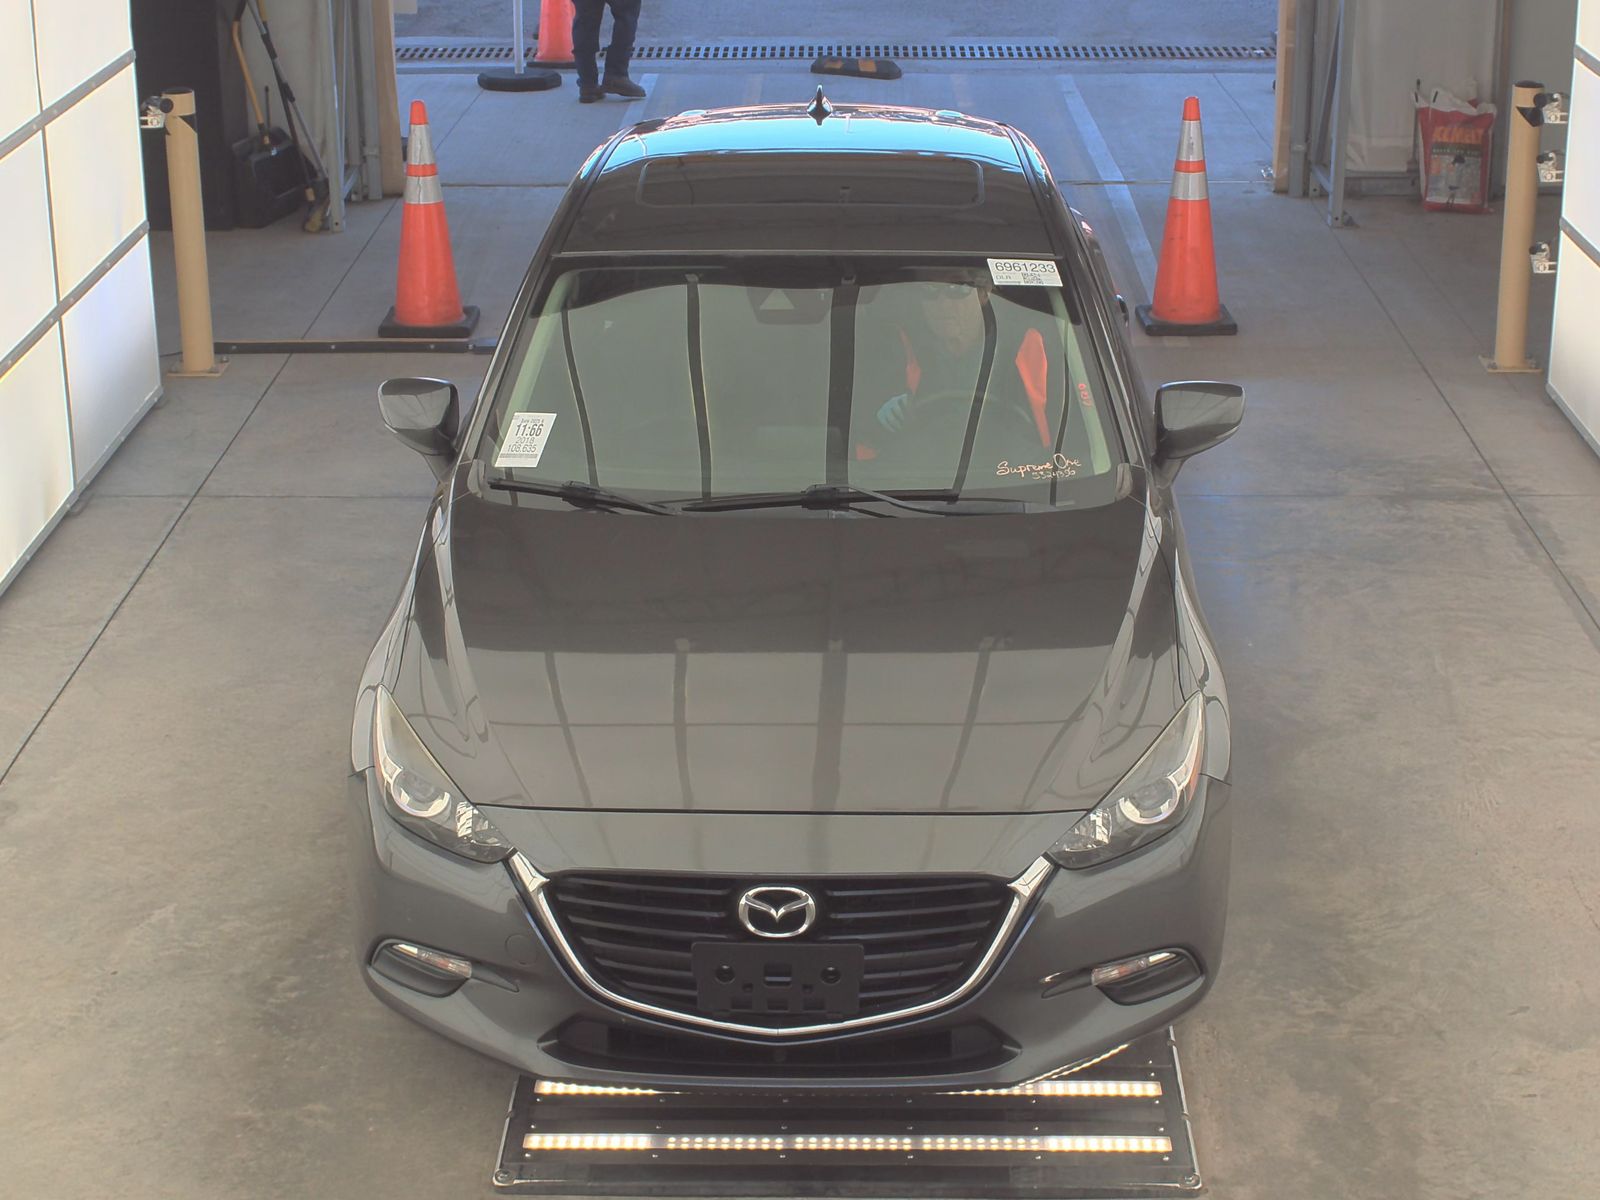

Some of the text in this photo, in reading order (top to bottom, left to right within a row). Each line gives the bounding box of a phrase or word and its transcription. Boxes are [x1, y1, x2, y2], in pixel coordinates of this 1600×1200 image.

[994, 261, 1056, 273] 6961233
[515, 423, 544, 437] 11:66
[996, 453, 1082, 478] Supreme One
